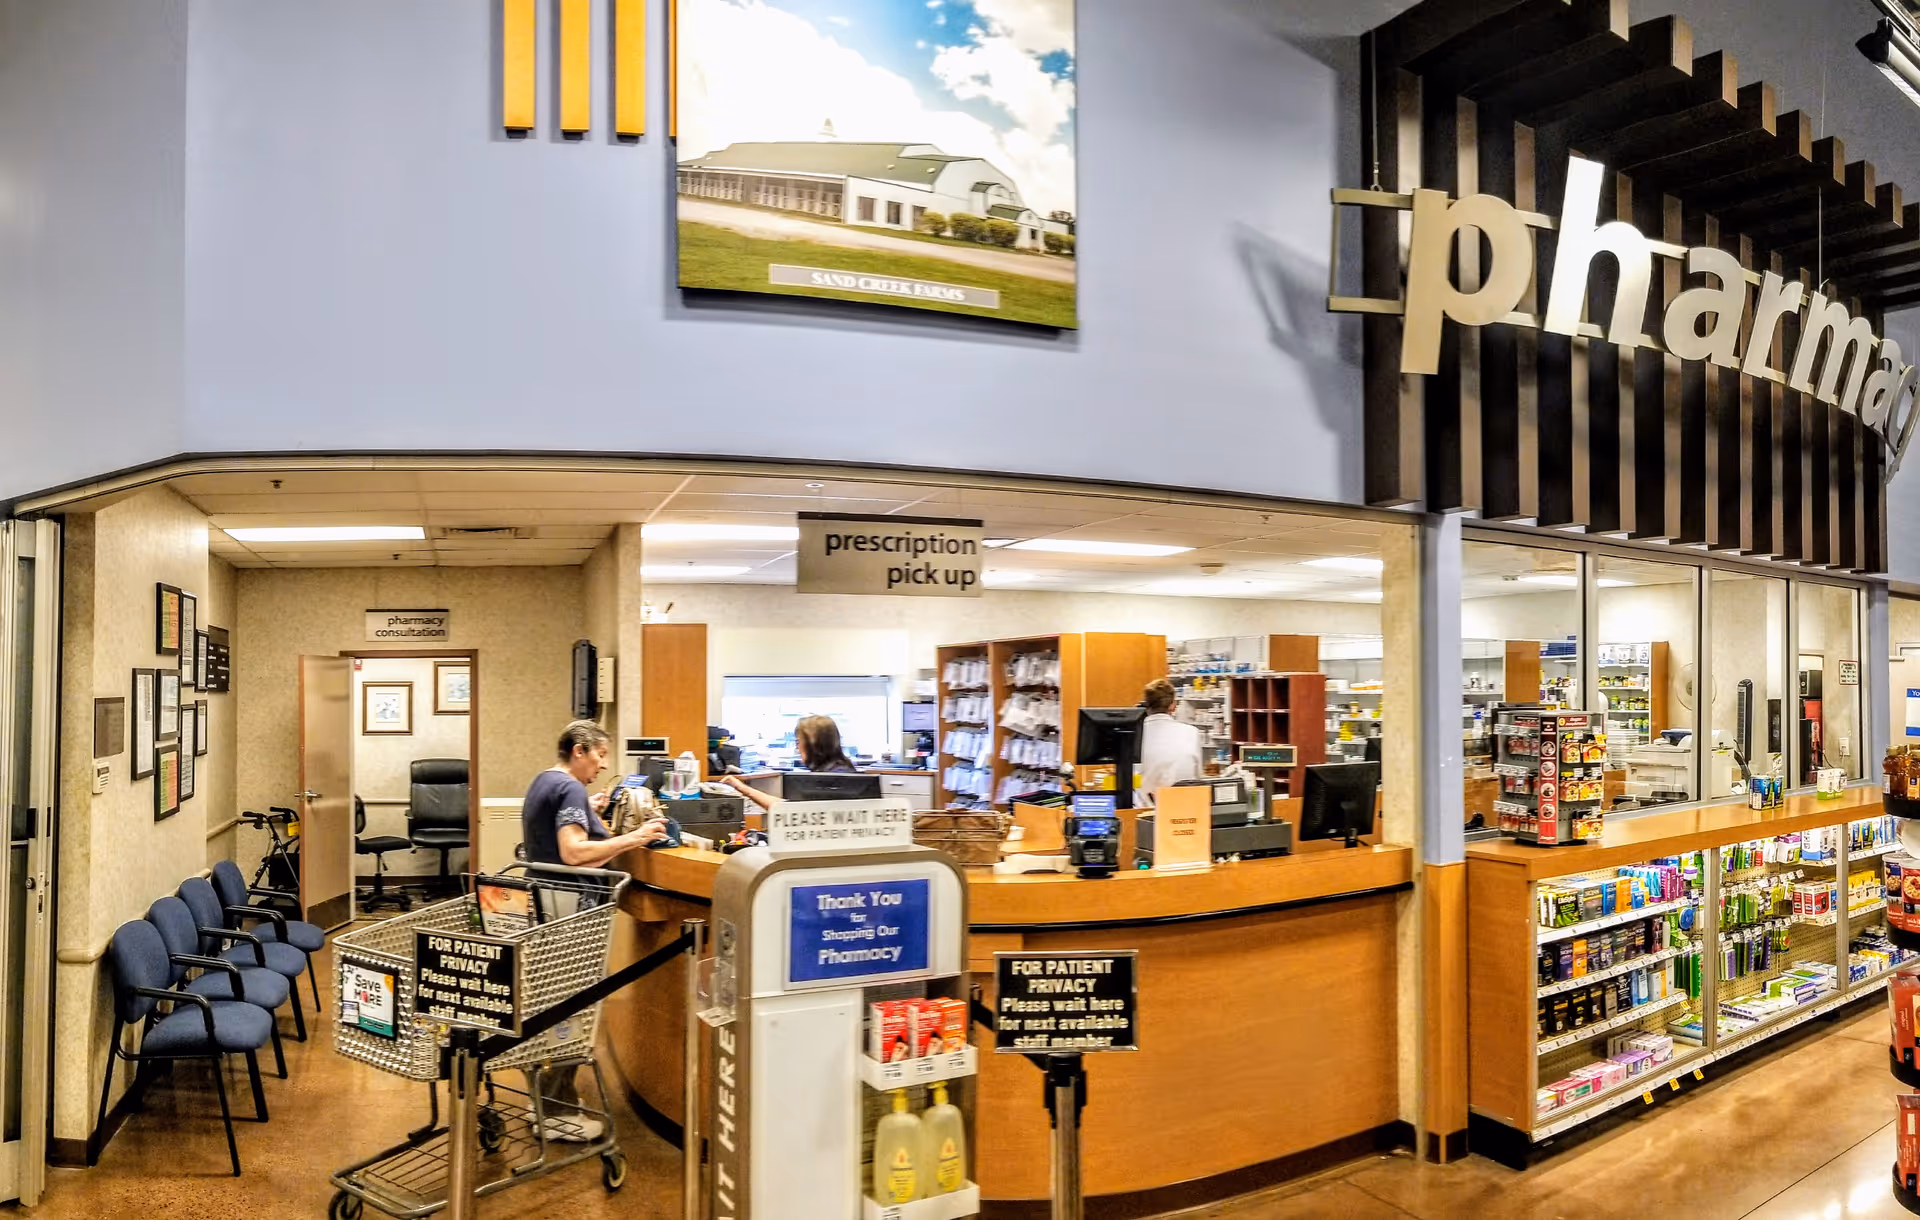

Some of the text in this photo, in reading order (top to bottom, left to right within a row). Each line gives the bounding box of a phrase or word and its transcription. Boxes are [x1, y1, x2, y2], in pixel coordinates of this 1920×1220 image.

[811, 271, 966, 301] SAND CREEK FARMS
[825, 531, 977, 559] prescription
[887, 561, 976, 591] pick up
[387, 615, 445, 628] pharmacy
[375, 627, 446, 637] consultation
[774, 808, 908, 828] PLEASE WAIT HERE
[784, 827, 896, 841] FOR PATIENT PRIVACY
[817, 890, 902, 910] Thank You
[850, 912, 867, 923] for
[821, 925, 900, 942] Shopping Our
[428, 936, 503, 960] FOR PATIENT
[818, 946, 903, 965] Pharmacy
[440, 954, 490, 975] PRIVACY
[1011, 959, 1114, 976] FOR PATIENT
[354, 974, 382, 993] Save
[421, 967, 511, 996] Please wait here
[1027, 978, 1097, 994] PRIVACY
[418, 983, 514, 1015] for next available
[1001, 996, 1125, 1012] Please wait here
[428, 1005, 501, 1028] staff member
[999, 1014, 1129, 1031] for next available
[1013, 1033, 1114, 1048] staff member
[718, 1026, 735, 1153] HERE
